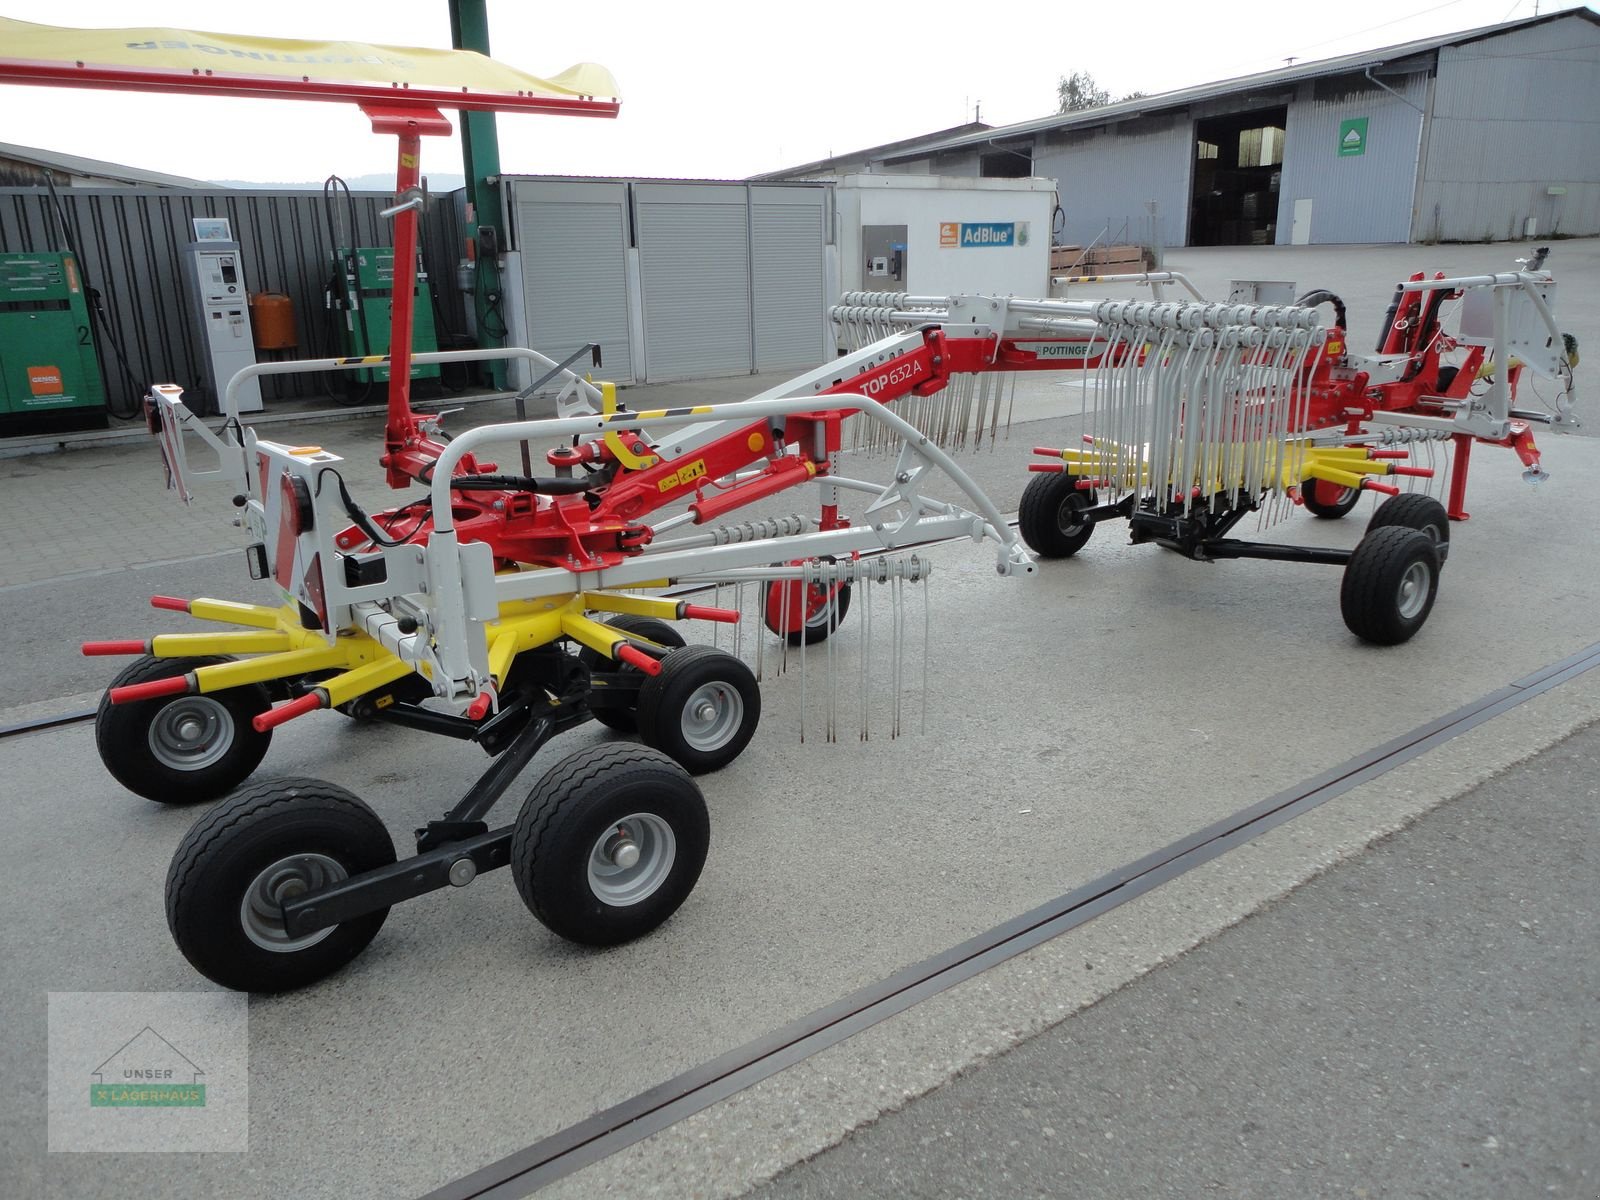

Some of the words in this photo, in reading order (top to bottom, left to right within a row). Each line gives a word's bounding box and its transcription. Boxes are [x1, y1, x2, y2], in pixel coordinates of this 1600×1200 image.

[964, 227, 1008, 243] AdBlue
[78, 326, 91, 345] 2
[860, 374, 888, 397] TOP
